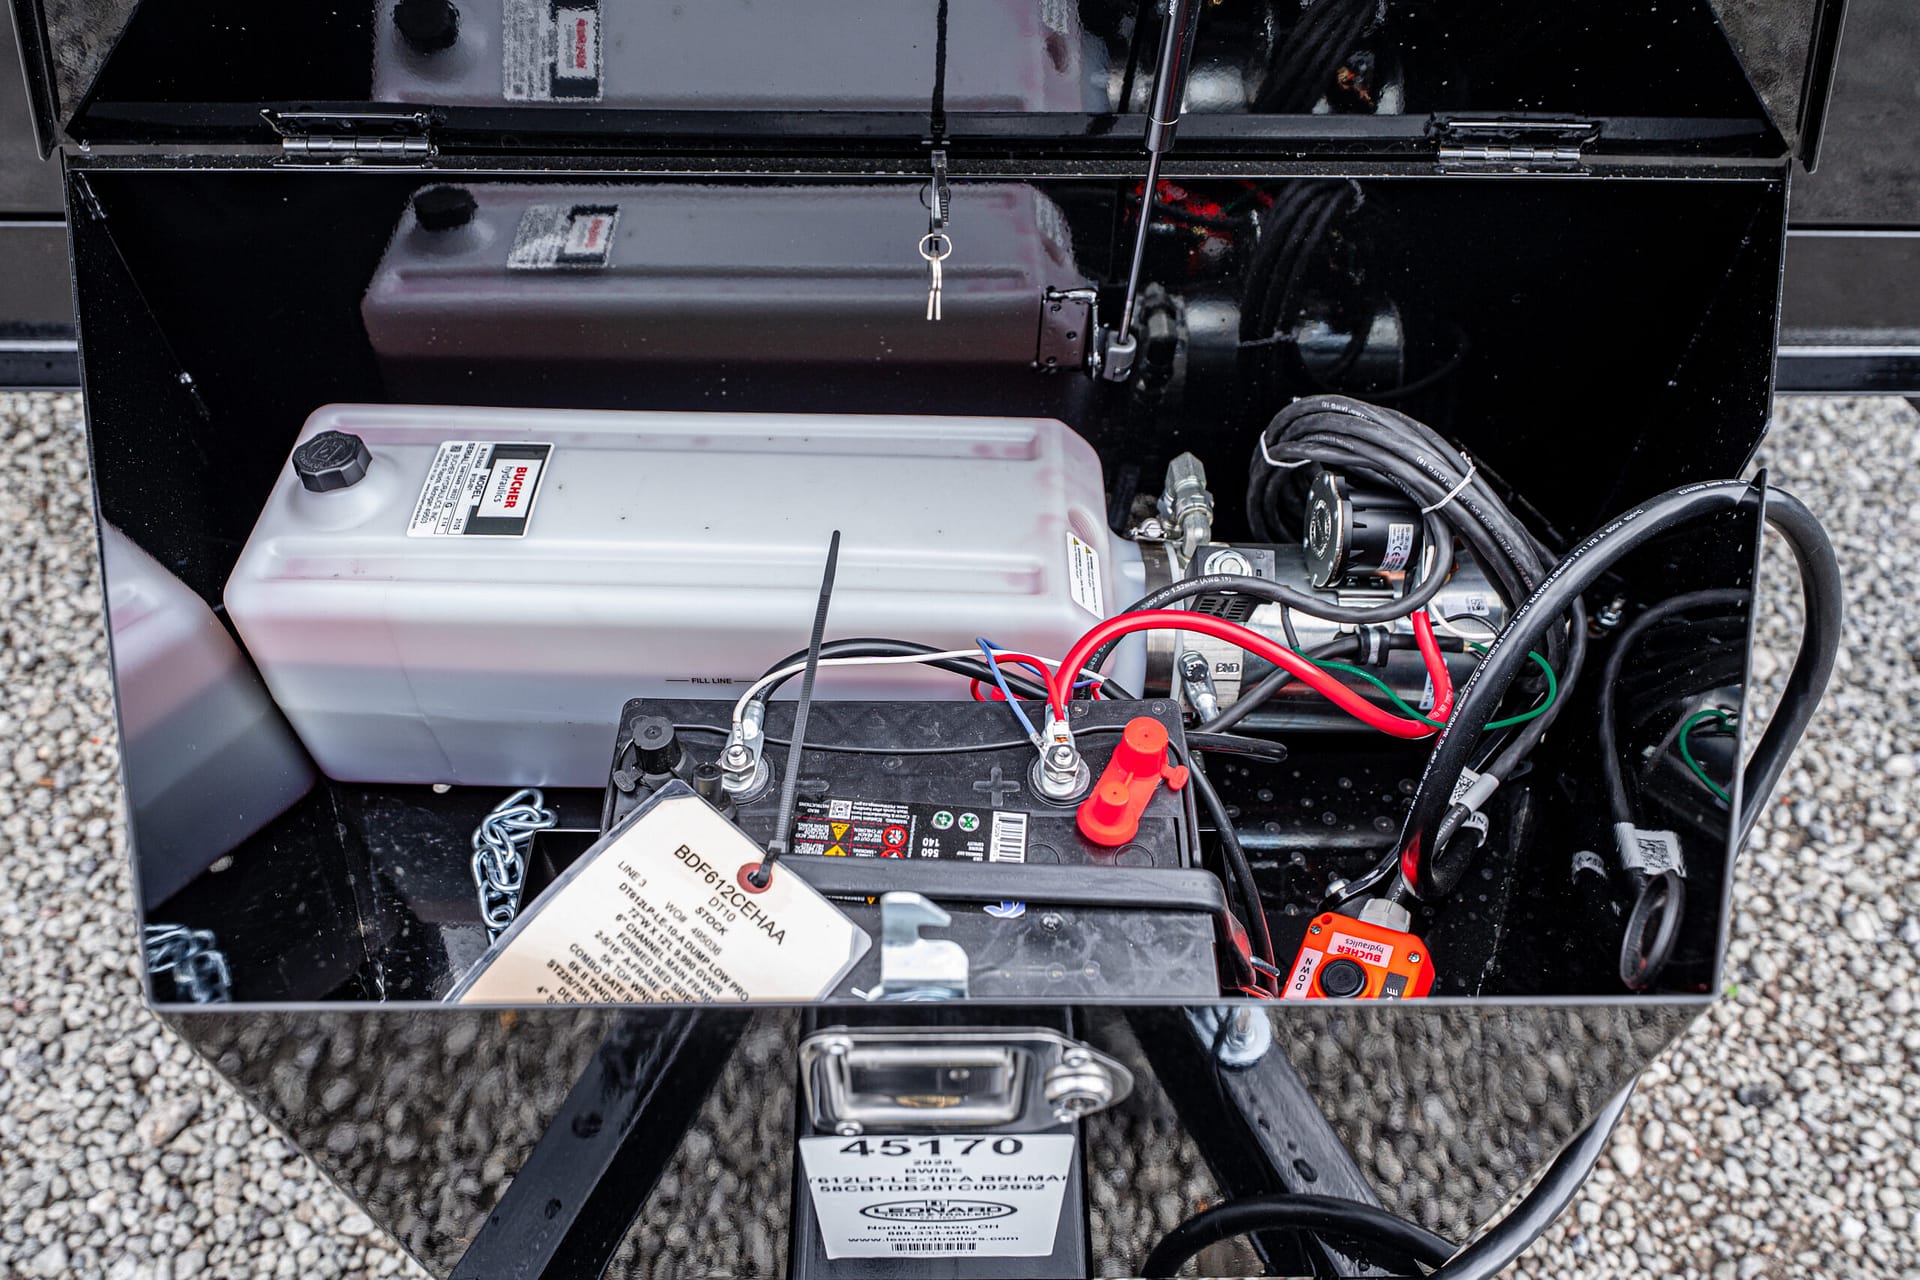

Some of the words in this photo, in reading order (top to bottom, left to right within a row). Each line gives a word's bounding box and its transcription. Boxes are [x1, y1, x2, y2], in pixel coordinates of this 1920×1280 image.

[460, 443, 475, 463] SERIAL
[472, 475, 487, 499] MODEL
[494, 466, 515, 502] hydraulics
[504, 467, 527, 508] BUCHER
[921, 848, 939, 858] 560
[922, 838, 940, 847] 140
[617, 860, 640, 881] LINE
[637, 878, 647, 888] 3
[664, 901, 688, 924] WO#
[689, 924, 722, 956] 495036
[673, 842, 788, 945] BDF612CEHAA
[707, 895, 736, 922] DT10
[694, 905, 728, 936] STOCK
[616, 931, 653, 968] FORMED
[652, 965, 671, 984] BED
[618, 881, 686, 943] DT612LP-LE-10-A
[683, 941, 710, 965] DUMP
[708, 962, 730, 984] LOW
[728, 981, 749, 1002] PRO
[624, 922, 665, 960] CHANNEL
[663, 957, 687, 980] MAIN
[1337, 944, 1381, 963] BUCHER
[1345, 938, 1384, 954] hydraulics
[567, 960, 581, 974] 6K
[568, 942, 602, 975] COMBO
[594, 929, 624, 957] 2-5/16"
[621, 955, 660, 992] A-FRAME
[599, 953, 613, 967] 5K
[612, 965, 631, 983] TOP
[648, 926, 658, 936] X
[693, 968, 723, 995] GVWR
[1296, 957, 1313, 990] DOWN
[839, 1137, 1023, 1157] 45170
